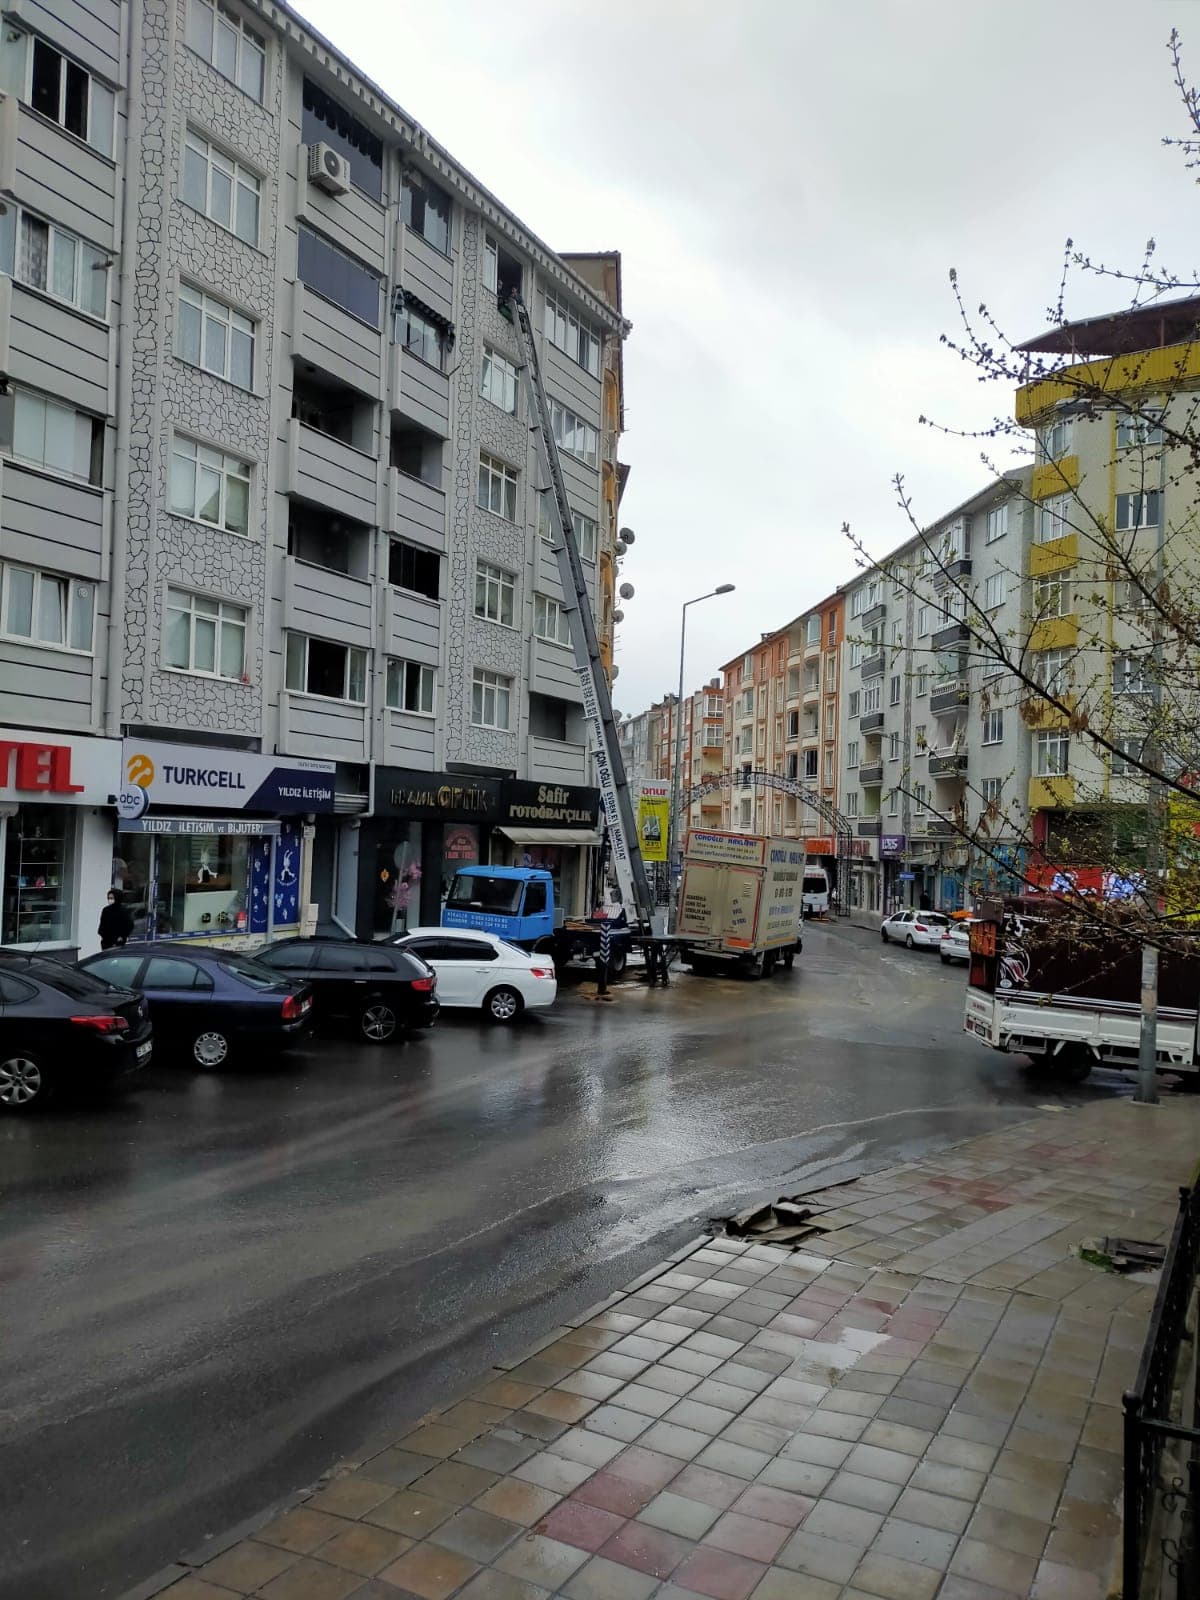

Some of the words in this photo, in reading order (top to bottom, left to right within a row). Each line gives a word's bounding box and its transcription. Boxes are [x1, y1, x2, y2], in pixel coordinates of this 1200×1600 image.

[163, 766, 245, 790] TURKCELL
[119, 793, 140, 805] abc
[278, 786, 302, 798] YILDIZ
[302, 786, 331, 801] İLETİŞİM
[537, 785, 570, 805] Safir
[606, 791, 617, 812] EVDEN
[510, 804, 592, 823] FOTOĞRAFÇILIK
[142, 820, 171, 832] YILDIZ
[614, 828, 626, 860] NAKLİYAT
